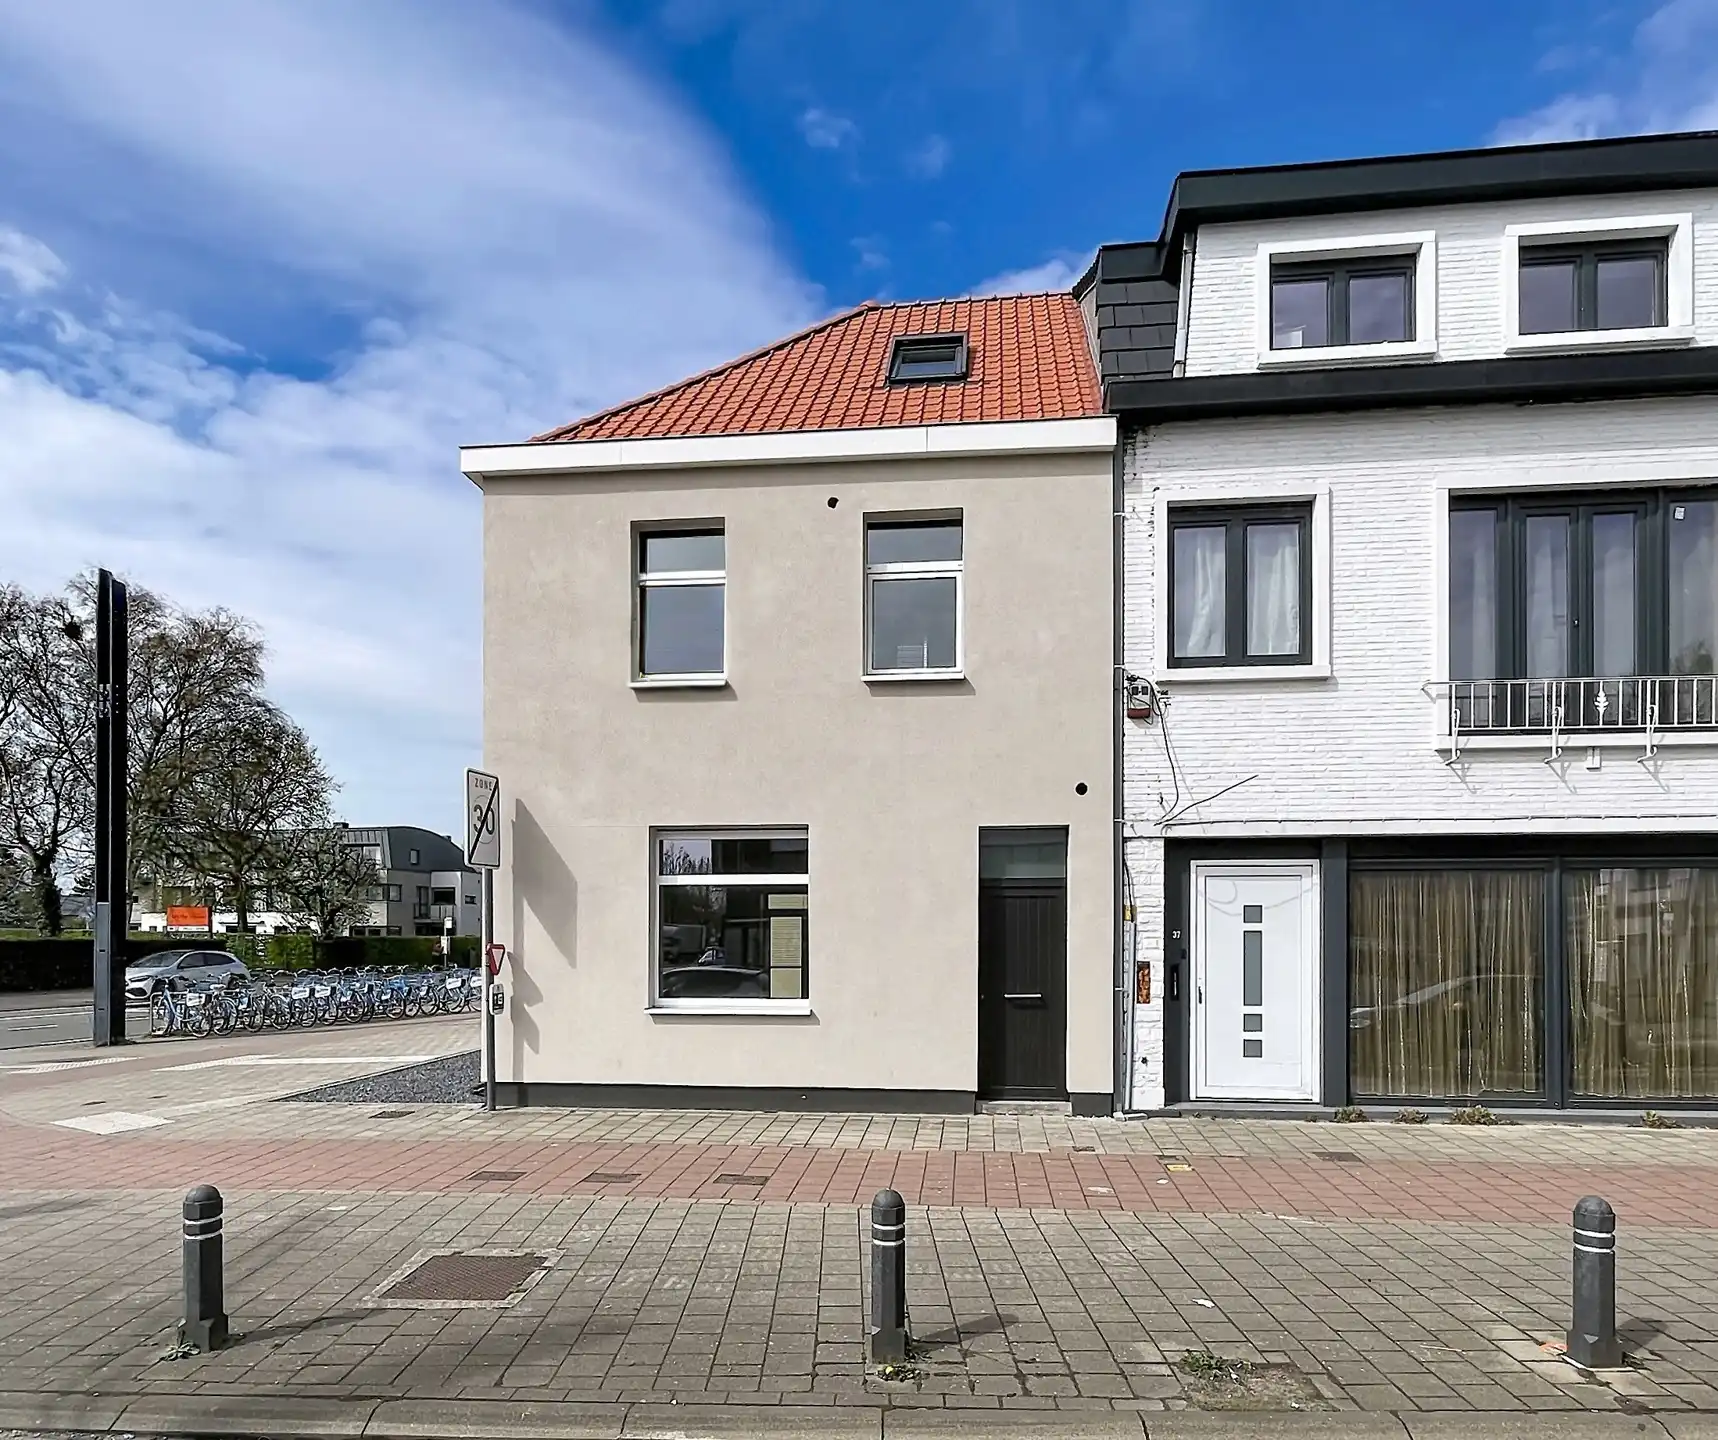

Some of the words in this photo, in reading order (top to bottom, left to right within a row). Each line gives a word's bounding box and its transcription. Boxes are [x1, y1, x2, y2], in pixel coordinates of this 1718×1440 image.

[475, 778, 492, 791] ZONE
[473, 804, 495, 835] 30
[1172, 930, 1181, 939] 37
